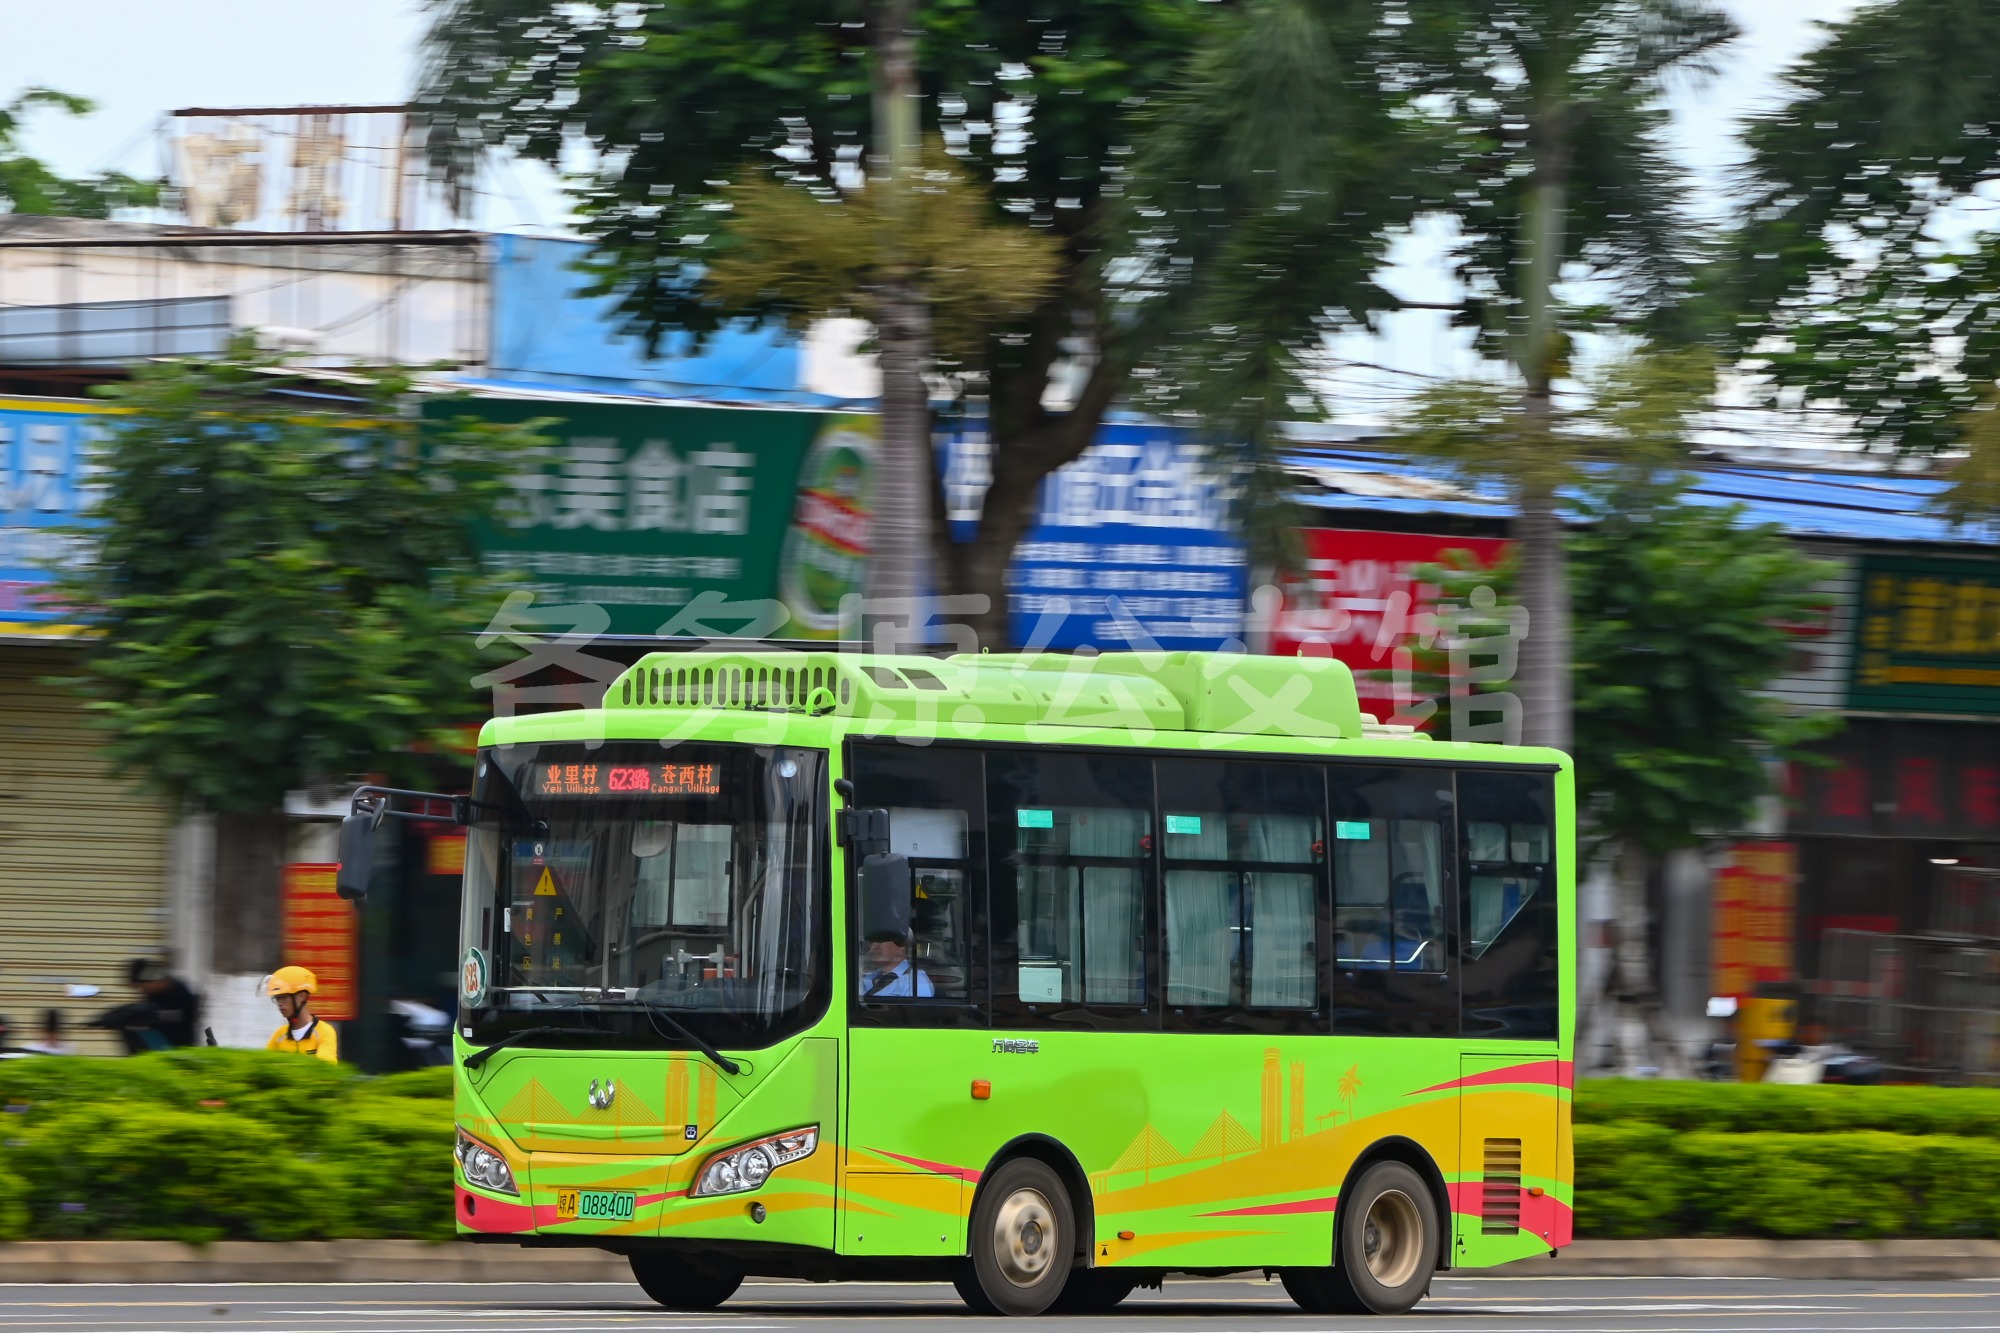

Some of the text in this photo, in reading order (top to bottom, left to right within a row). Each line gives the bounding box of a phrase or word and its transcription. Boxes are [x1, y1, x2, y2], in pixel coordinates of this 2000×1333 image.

[547, 764, 713, 791] 业里村 623路 苍西村
[542, 784, 562, 793] Yeli
[651, 783, 683, 795] Cangxi
[582, 1195, 634, 1217] 08840D
